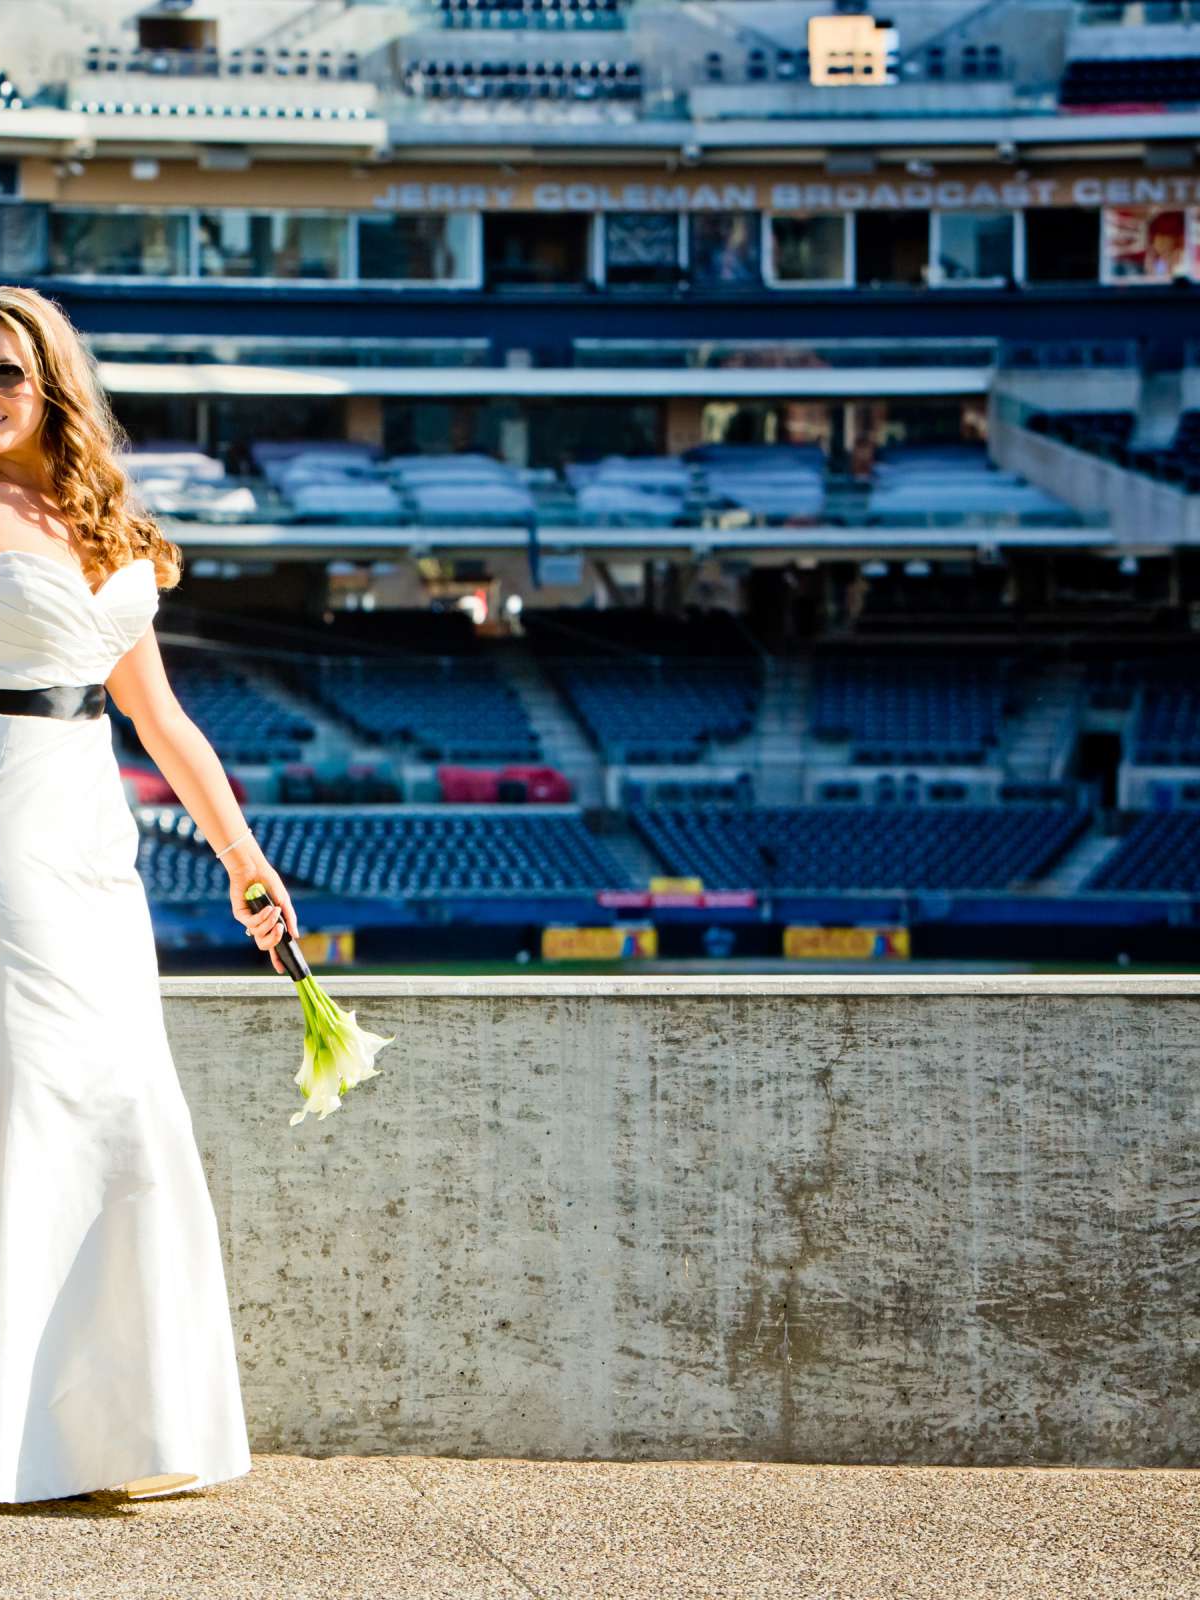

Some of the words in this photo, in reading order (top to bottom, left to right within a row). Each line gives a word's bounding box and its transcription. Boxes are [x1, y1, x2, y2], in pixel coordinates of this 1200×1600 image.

[373, 182, 513, 210] JERRY
[532, 182, 757, 210] COLEMAN
[770, 180, 1057, 208] BROADCAST
[1072, 177, 1200, 204] CENT
